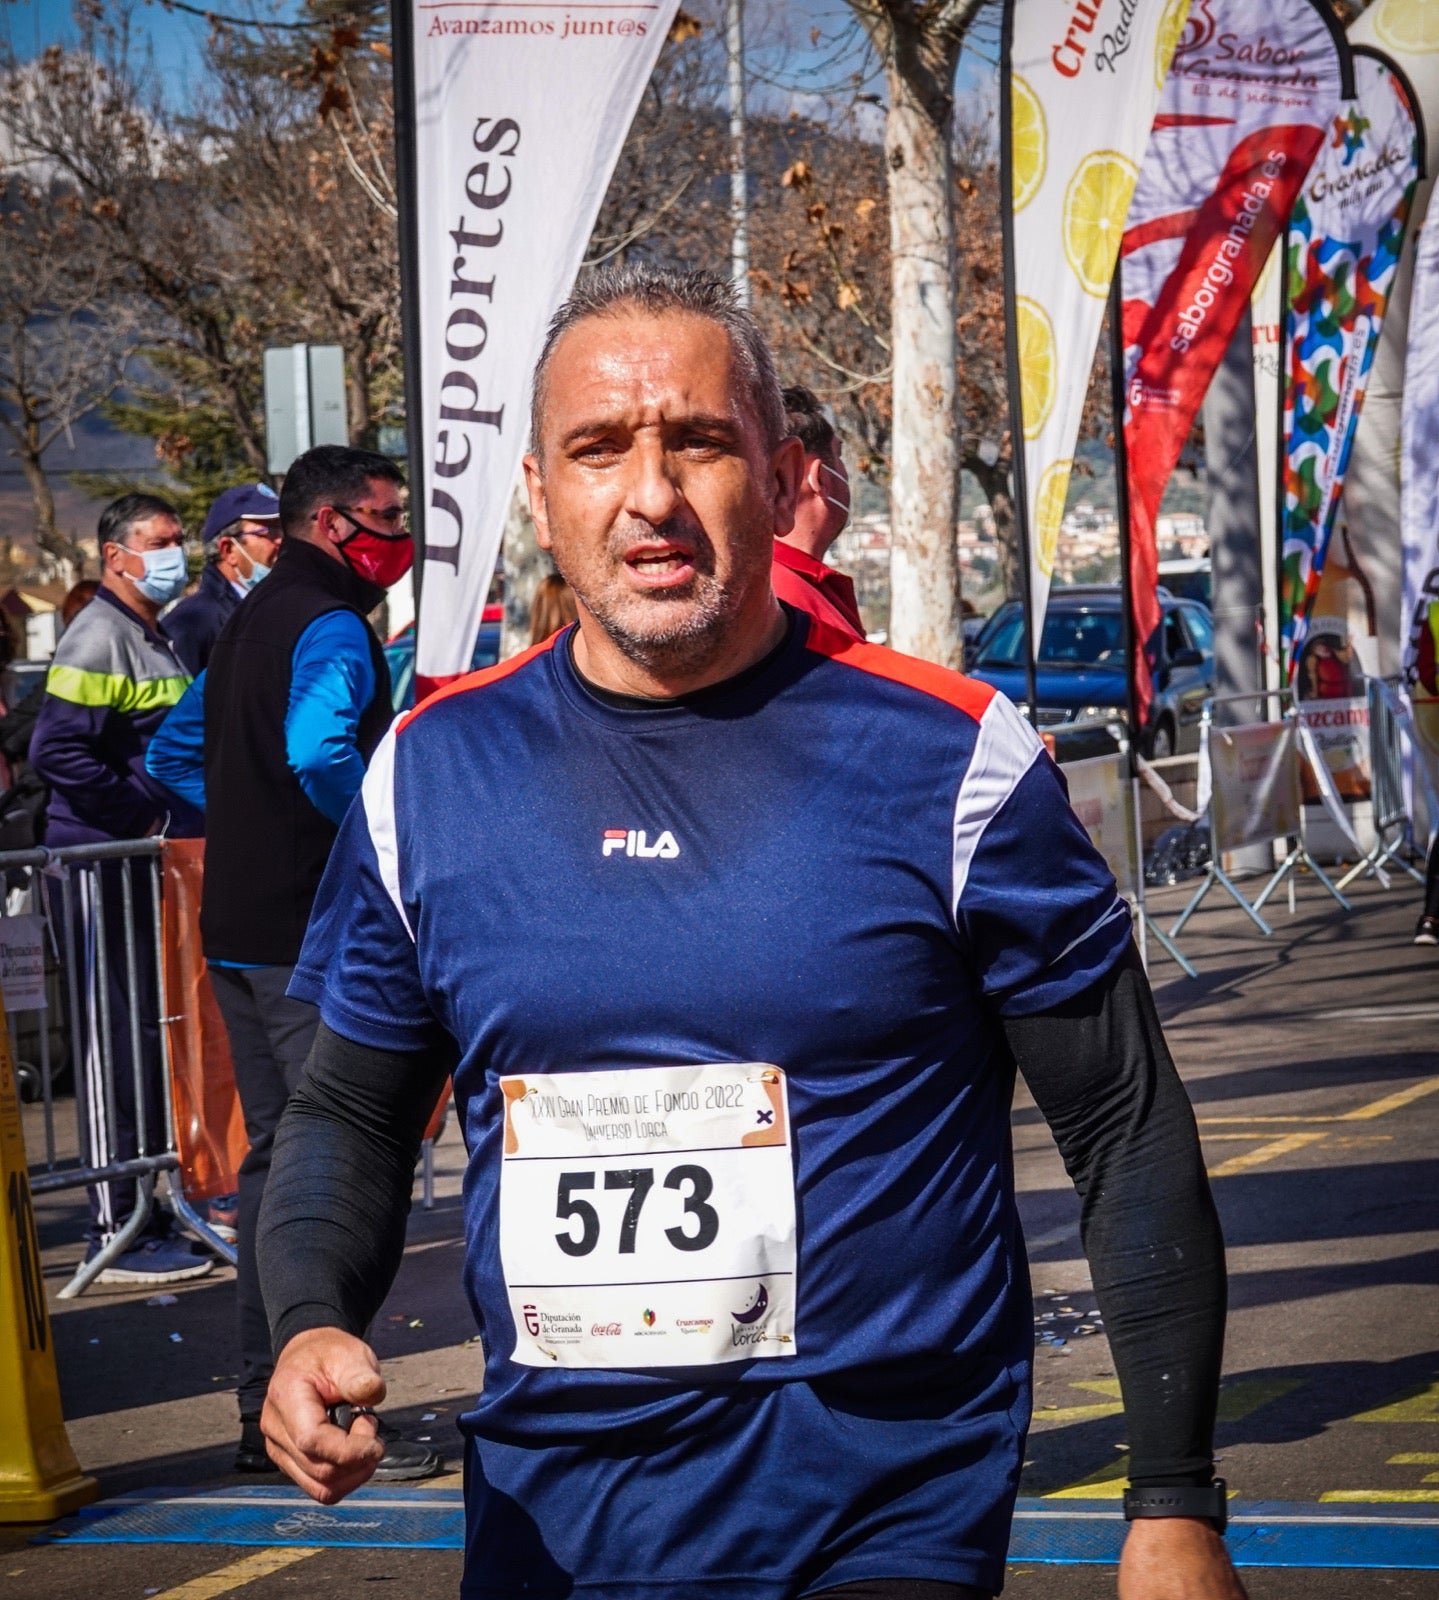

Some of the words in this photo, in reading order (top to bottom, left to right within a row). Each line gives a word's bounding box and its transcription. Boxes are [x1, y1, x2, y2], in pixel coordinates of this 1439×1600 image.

[427, 15, 554, 37] Avanzamos
[560, 15, 647, 39] junt@s
[1215, 33, 1305, 66] Sabor
[1310, 143, 1406, 202] Granada
[1170, 150, 1287, 354] saborgranada.es
[424, 117, 521, 577] Deportes
[602, 829, 680, 859] FILA
[634, 1094, 650, 1114] DE
[655, 1089, 699, 1113] FONDO
[705, 1083, 744, 1109] 2022
[634, 1119, 668, 1138] LORCA
[554, 1163, 719, 1257] 573
[540, 1312, 582, 1324] Diputación
[551, 1323, 583, 1333] Granada
[676, 1318, 714, 1328] Cruzcampo
